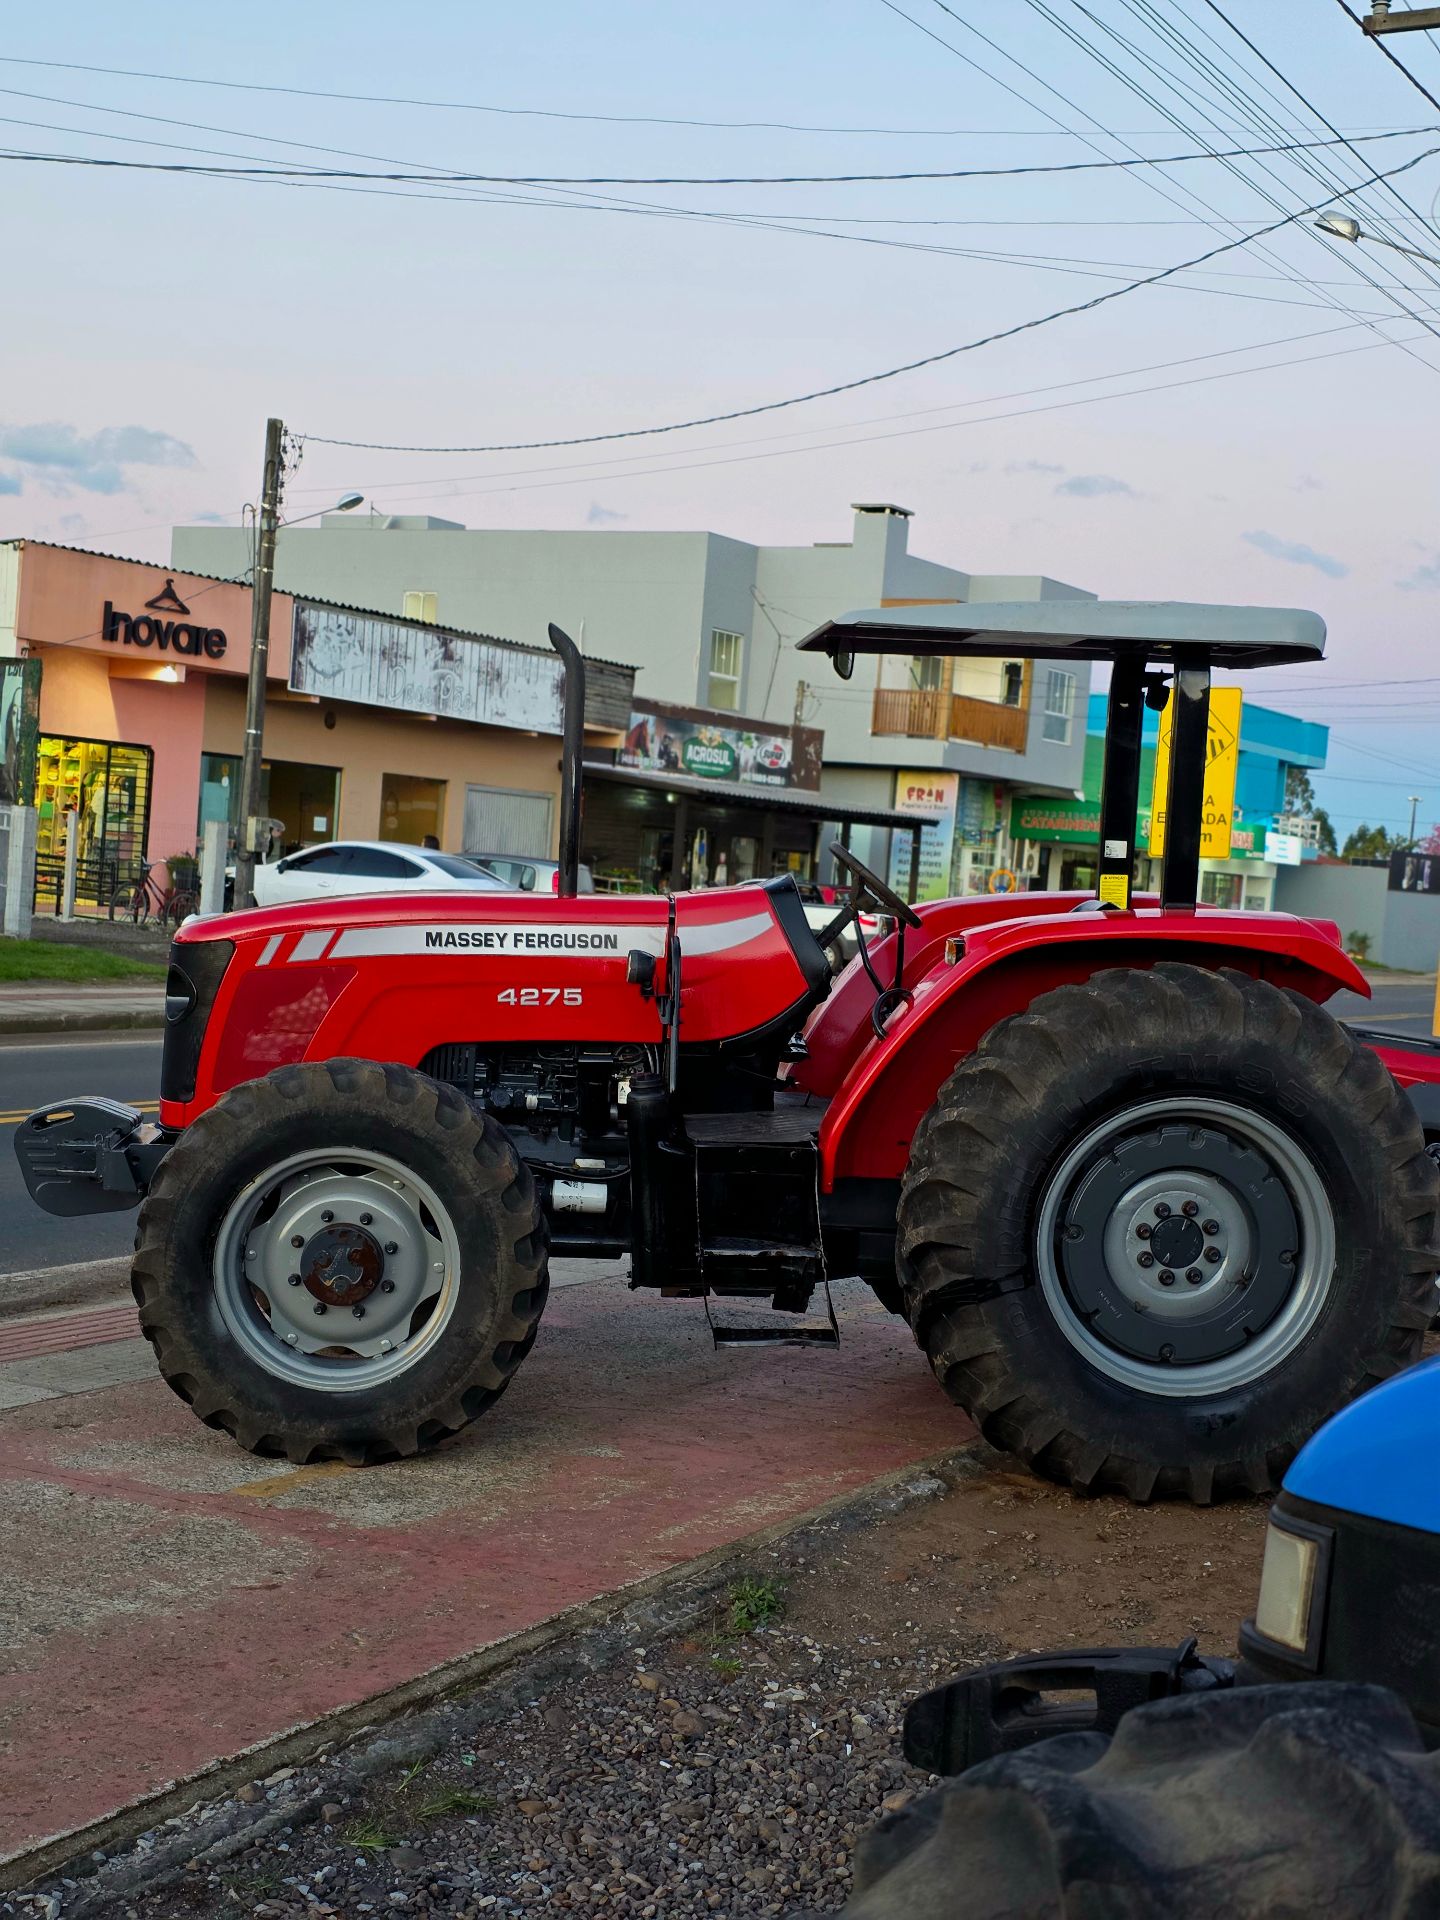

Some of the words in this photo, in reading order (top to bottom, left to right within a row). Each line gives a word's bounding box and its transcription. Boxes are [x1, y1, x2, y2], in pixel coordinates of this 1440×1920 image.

[102, 600, 227, 659] Inovare
[907, 787, 944, 803] FRAN
[425, 931, 508, 949] MASSEY
[513, 932, 618, 950] FERGUSON
[497, 988, 583, 1006] 4275
